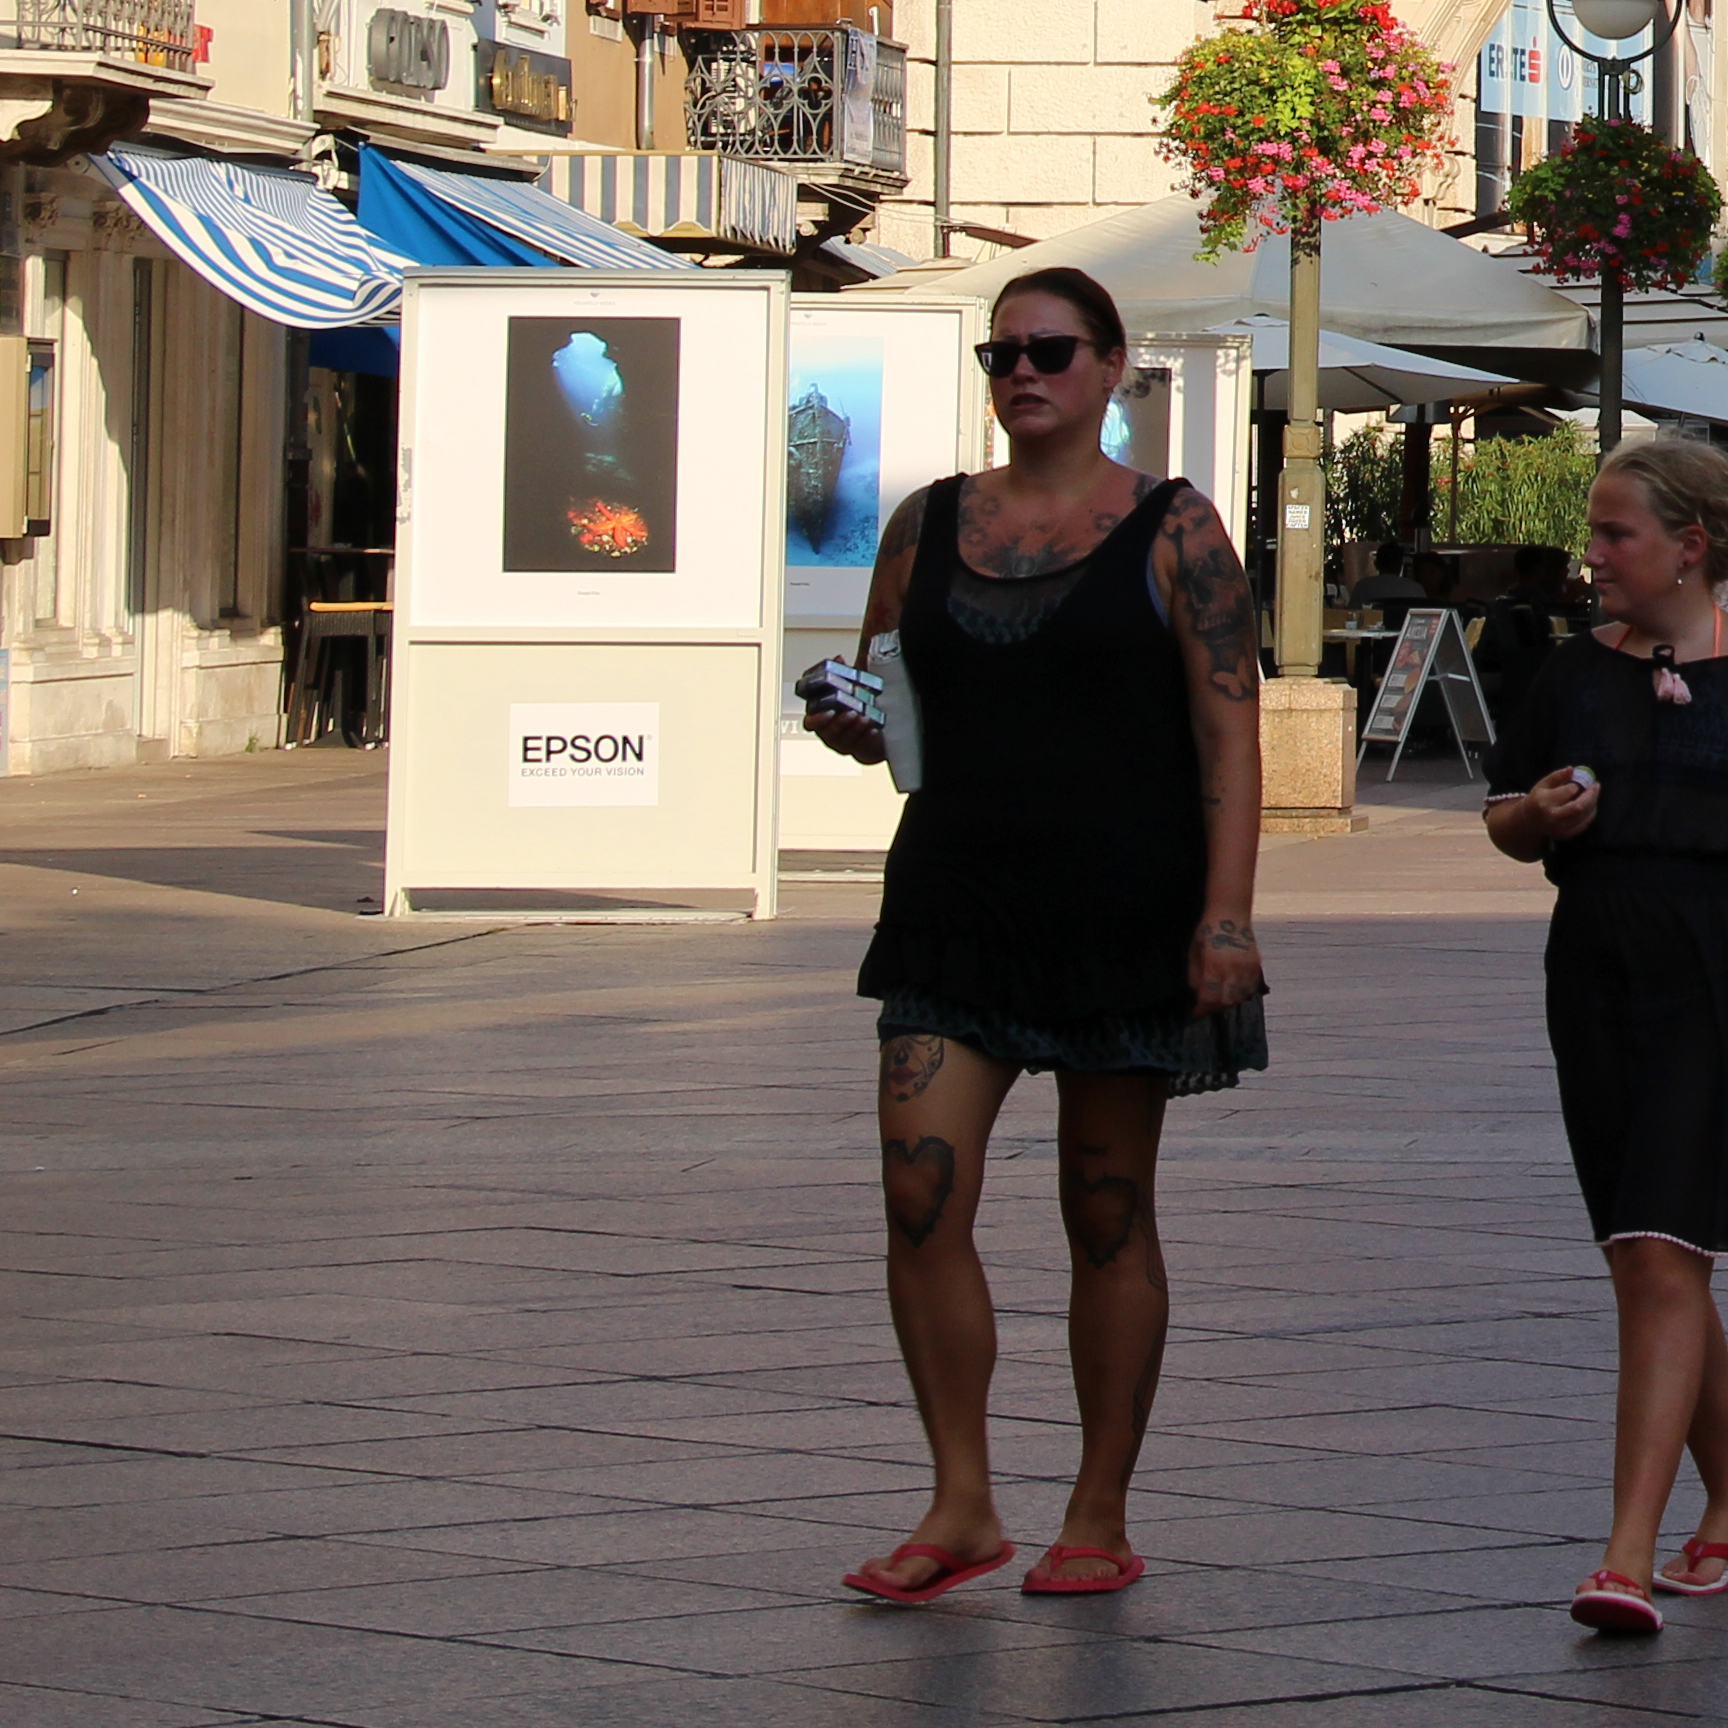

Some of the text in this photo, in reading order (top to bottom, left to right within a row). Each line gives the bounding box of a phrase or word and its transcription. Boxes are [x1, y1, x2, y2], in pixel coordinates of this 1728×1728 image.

[1488, 43, 1527, 82] ERTE
[521, 734, 644, 763] EPSON
[521, 767, 645, 777] EXCEED YOUR VISION
